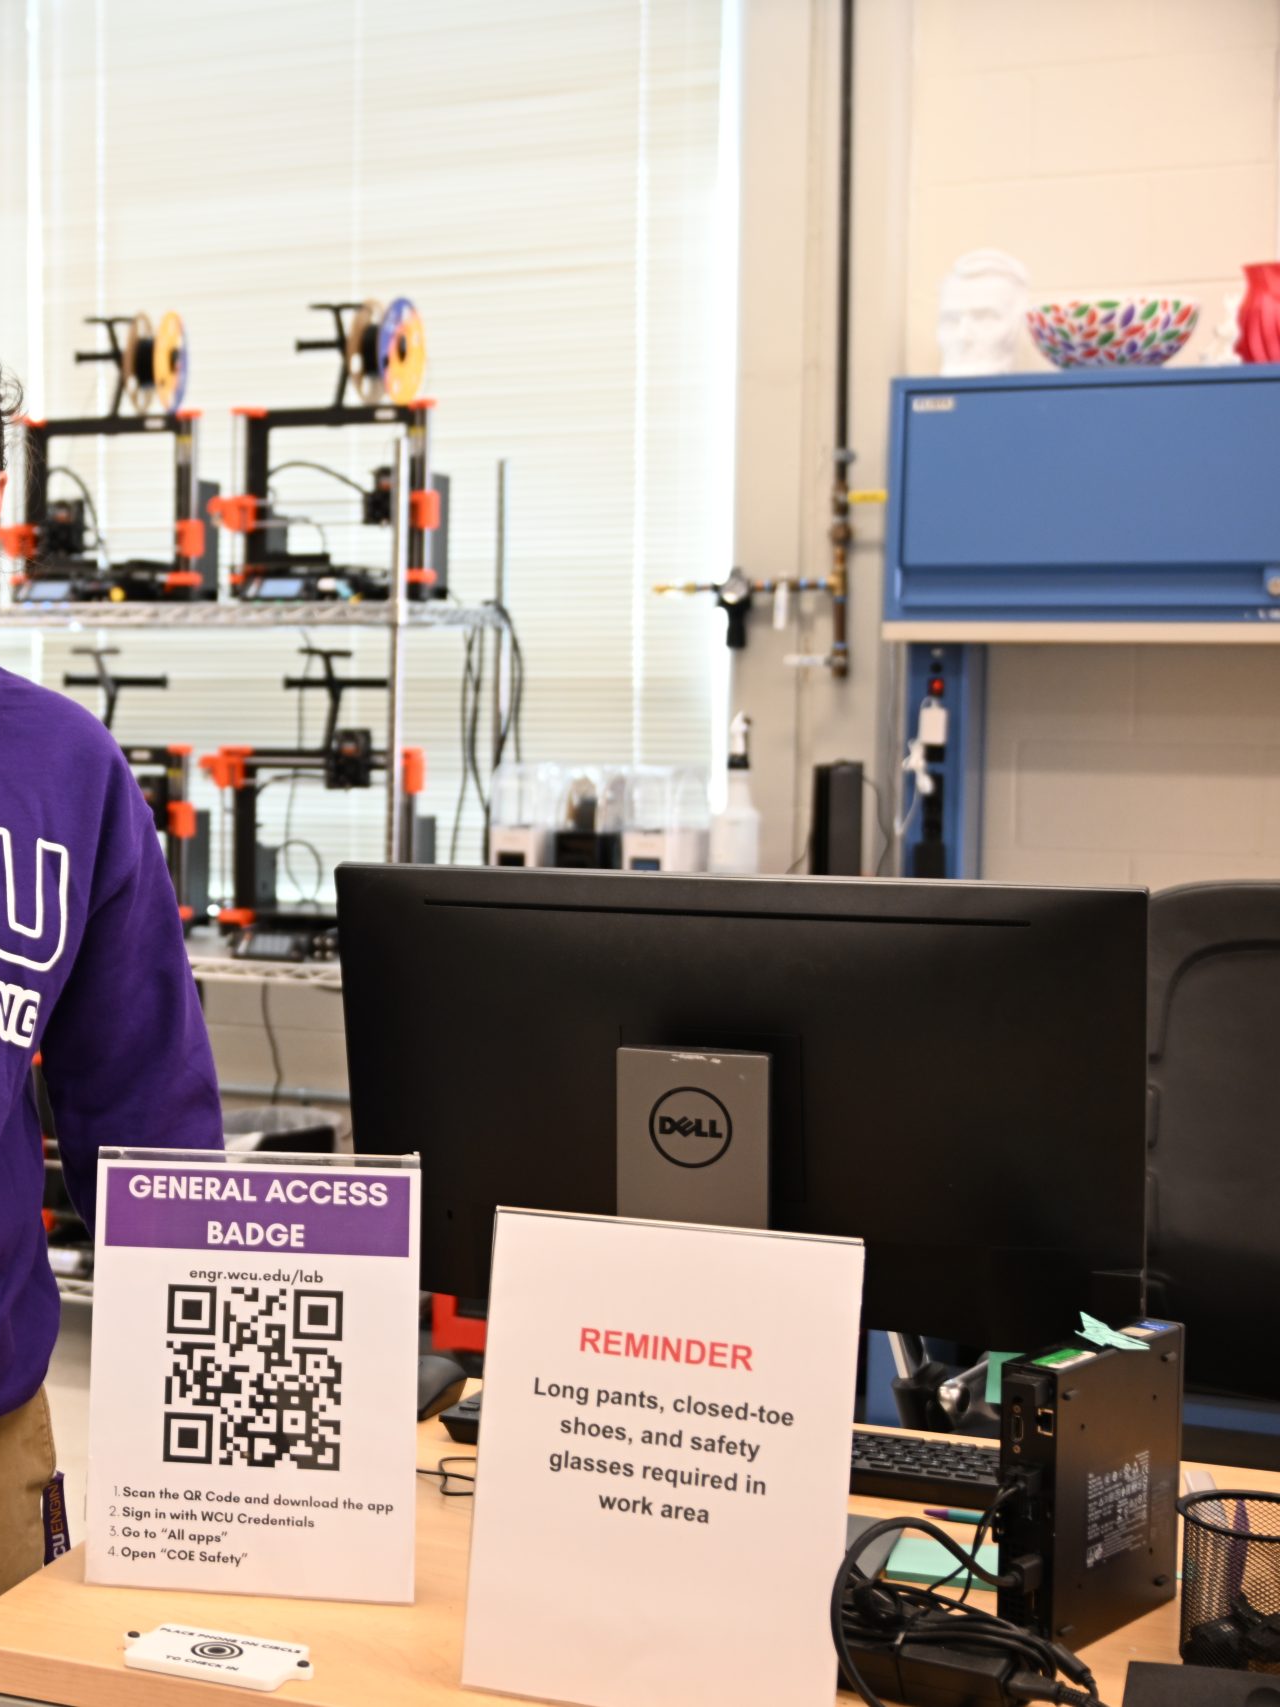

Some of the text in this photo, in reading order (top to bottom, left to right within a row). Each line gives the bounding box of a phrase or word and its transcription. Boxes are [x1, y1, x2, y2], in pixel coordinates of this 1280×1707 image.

[658, 1115, 723, 1139] DELL
[128, 1174, 389, 1207] GENERAL ACCESS
[206, 1220, 306, 1248] BADGE
[189, 1267, 324, 1286] engr.wcu.edu/lab
[579, 1327, 753, 1372] REMINDER
[533, 1376, 795, 1427] Long pants, closed-toe
[560, 1416, 761, 1463] shoes, and safety
[549, 1450, 766, 1496] glasses required in
[122, 1486, 156, 1499] Scan
[159, 1487, 180, 1500] the
[183, 1489, 202, 1501] QR
[205, 1490, 241, 1504] Code
[244, 1493, 270, 1505] and
[272, 1493, 339, 1509] download
[342, 1497, 364, 1511] the
[367, 1503, 394, 1516] app
[598, 1494, 709, 1524] work area
[122, 1506, 151, 1522] Sign
[154, 1508, 167, 1520] in
[169, 1509, 198, 1521] with
[200, 1510, 234, 1524] WCU
[236, 1512, 315, 1528] Credentials
[121, 1526, 141, 1538] Go
[143, 1528, 157, 1539] to
[120, 1546, 156, 1562] Open
[159, 1627, 196, 1637] PLACE
[197, 1633, 238, 1644] PHONE
[261, 1644, 302, 1654] CIRCLE
[184, 1658, 223, 1669] CHECK
